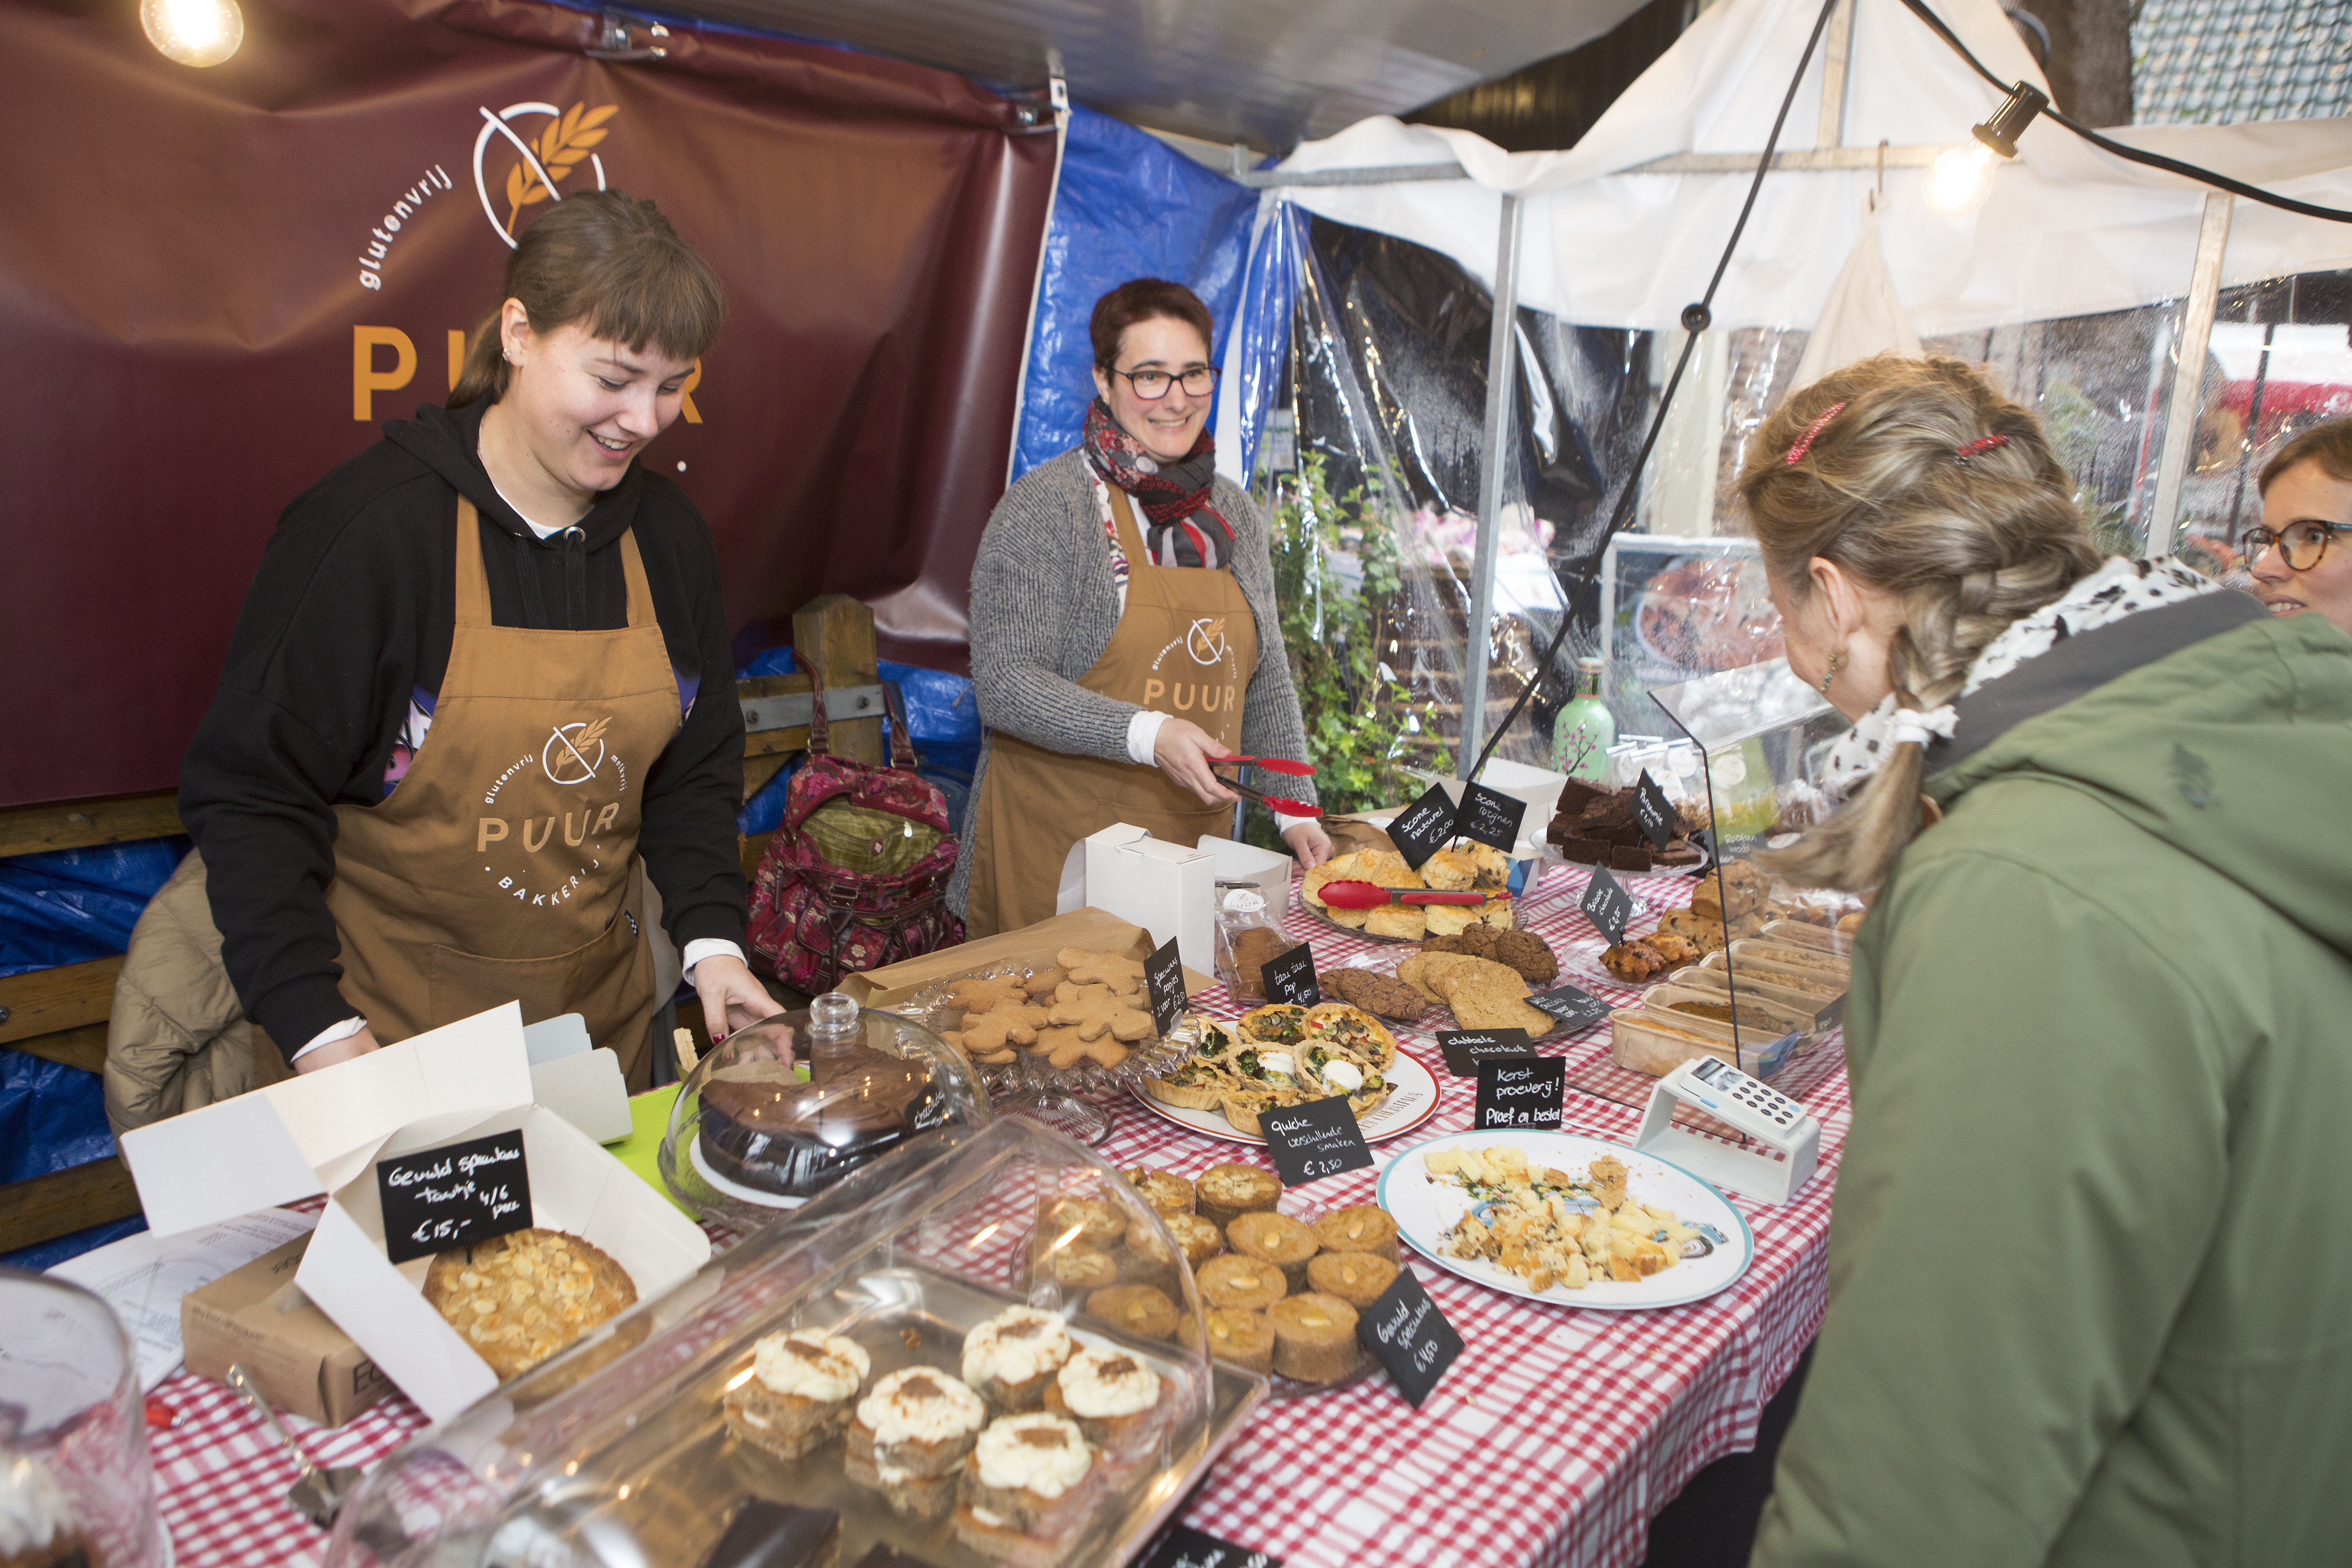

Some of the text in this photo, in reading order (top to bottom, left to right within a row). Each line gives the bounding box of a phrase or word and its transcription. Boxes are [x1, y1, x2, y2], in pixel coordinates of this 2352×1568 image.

[358, 164, 453, 291] glutenvrij
[1143, 678, 1235, 712] PUUR
[485, 754, 533, 804] glutenvrij
[611, 754, 627, 791] melkvrij
[1410, 807, 1444, 840] naturel
[1640, 787, 1663, 827] Brownie
[477, 803, 620, 853] PUUR
[498, 859, 599, 906] BAKKERIJ
[1164, 975, 1178, 996] popjes
[1284, 982, 1296, 997] pop
[1161, 998, 1170, 1013] voor
[1497, 1067, 1534, 1082] Kerst
[1371, 1092, 1423, 1121] CHRISTMAS
[1486, 1107, 1515, 1126] Proef
